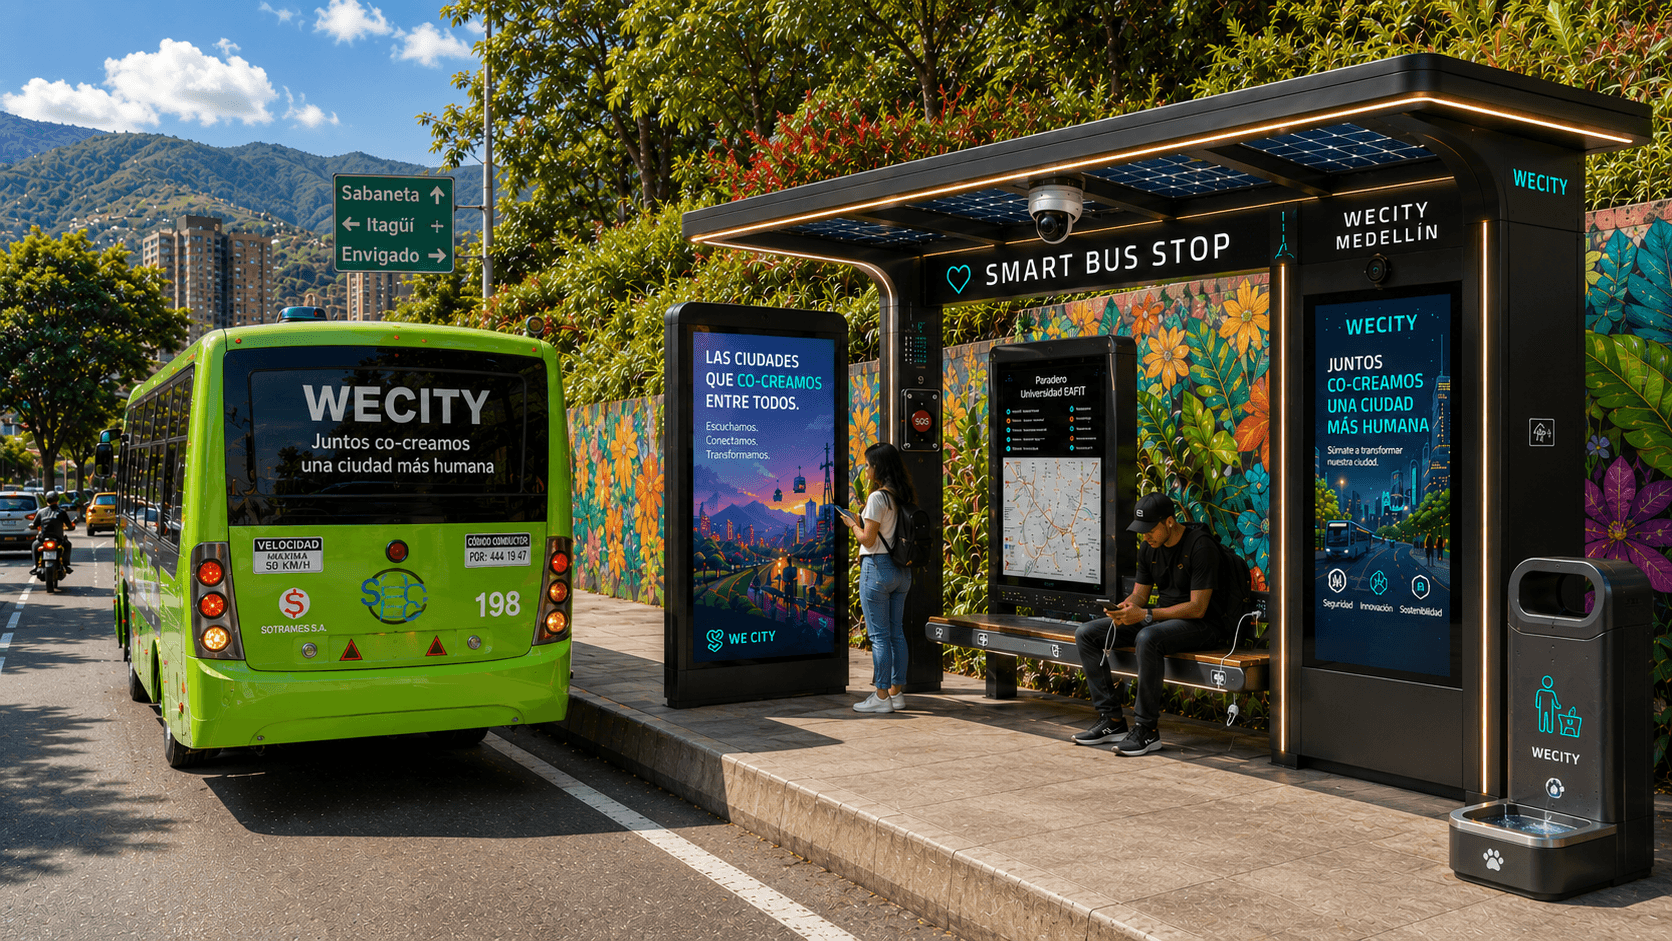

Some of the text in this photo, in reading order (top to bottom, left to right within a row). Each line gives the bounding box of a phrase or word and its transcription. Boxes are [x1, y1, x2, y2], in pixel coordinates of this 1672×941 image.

[1512, 168, 1568, 195] WECITY
[342, 184, 419, 202] Sabaneta
[1343, 201, 1428, 227] WECITY
[367, 216, 414, 235] Itagüí
[1335, 223, 1438, 249] MEDELLÍN
[342, 246, 419, 265] Envigado
[985, 232, 1230, 285] SMART BUS STOP
[1346, 313, 1417, 335] WECITY
[705, 350, 799, 368] LAS CIUDADES
[1327, 354, 1382, 372] JUNTOS
[705, 371, 822, 389] QUE CO-CREAMOS
[1035, 375, 1068, 385] Paradero
[1327, 373, 1423, 392] CO-CREAMOS
[1020, 387, 1062, 398] Universidad
[302, 384, 490, 424] WECITY
[705, 394, 799, 410] ENTRE TODOS.
[1327, 396, 1413, 413] UNA CIUDAD
[705, 421, 759, 432] Escuchamos.
[1327, 415, 1429, 434] MÁS HUMANA
[311, 433, 470, 450] Juntos co-creamos
[705, 435, 759, 446] Conectamos.
[705, 449, 771, 460] Transformamos.
[1327, 445, 1404, 455] Súmate a transformar
[301, 456, 494, 473] una ciudad más humana
[1327, 458, 1353, 466] nuestra
[257, 540, 320, 551] VELOCIDAD
[507, 550, 516, 561] 19
[517, 550, 527, 560] 47
[265, 560, 311, 570] 50 KM/H
[475, 590, 520, 617] 198
[260, 624, 327, 634] SOTRAMES S.A.
[728, 630, 775, 644] WE CITY
[1531, 746, 1580, 765] WECITY
